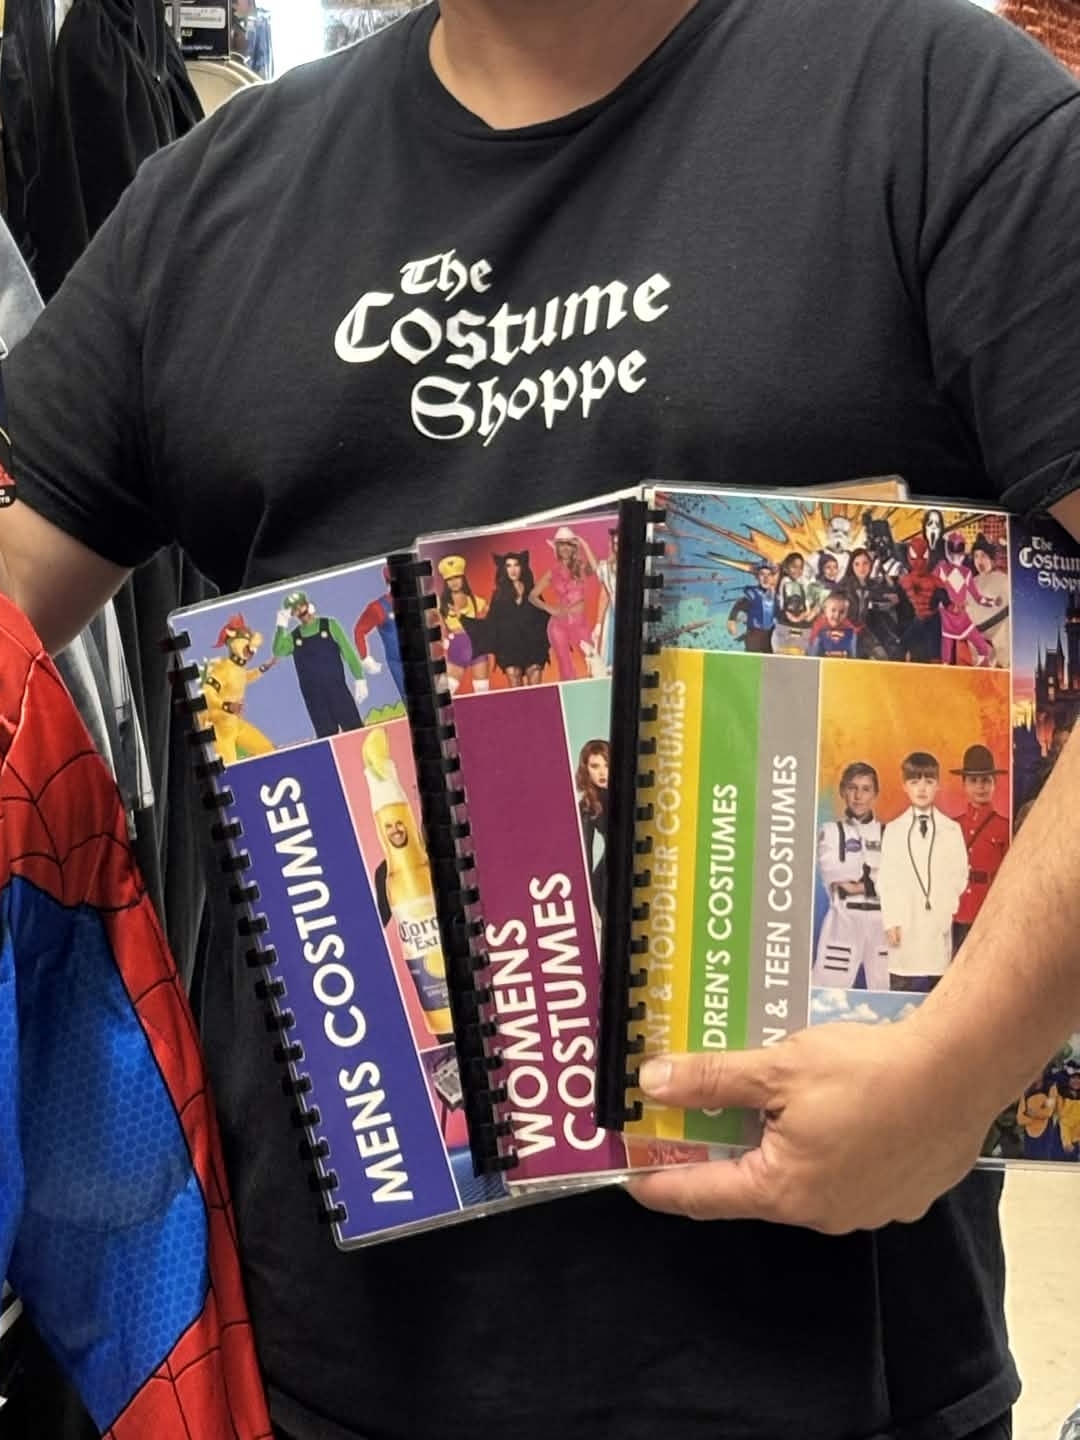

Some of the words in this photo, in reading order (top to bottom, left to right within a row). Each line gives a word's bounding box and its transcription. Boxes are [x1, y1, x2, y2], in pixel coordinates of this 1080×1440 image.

[334, 272, 671, 370] Costume
[400, 248, 493, 301] The
[410, 349, 648, 448] Shoppe
[1018, 547, 1080, 571] Costum
[655, 677, 688, 834] COSTUMES
[707, 783, 739, 942] COSTUMES
[767, 753, 799, 913] COSTUMES
[259, 775, 369, 1048] COSTUMES
[649, 844, 678, 983] TODDLER
[764, 920, 793, 989] TEEN
[485, 919, 557, 1160] WOMENS
[528, 872, 607, 1151] COSTUMES
[702, 949, 731, 1070] DREN'S
[764, 999, 789, 1018] &
[338, 1060, 415, 1204] MENS
